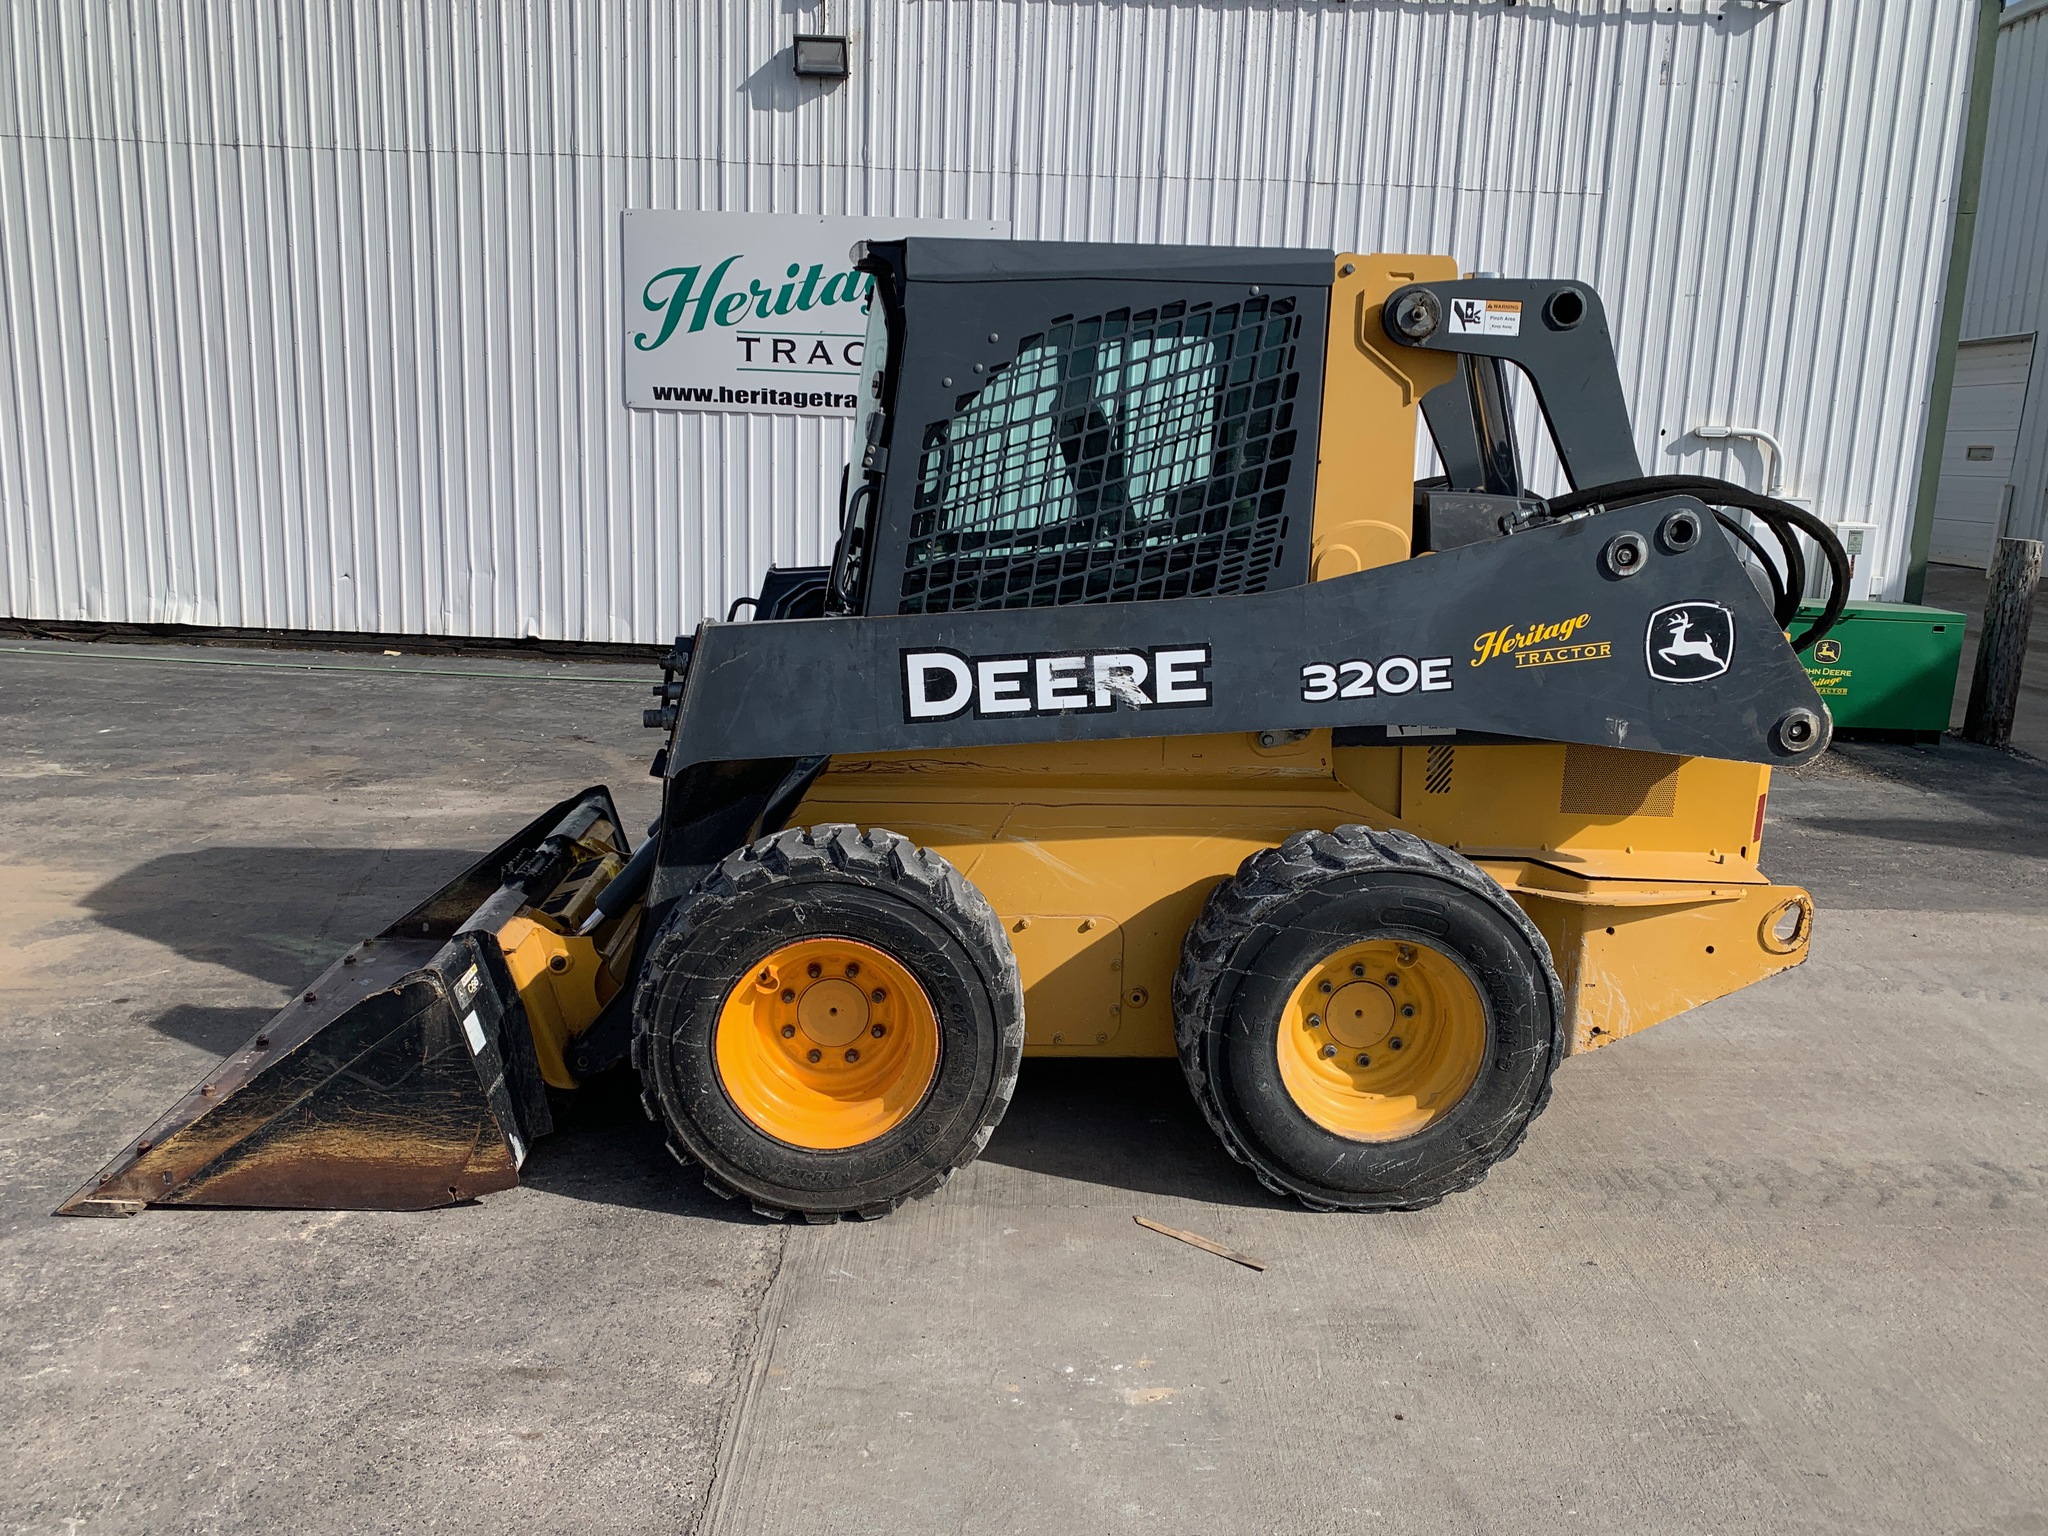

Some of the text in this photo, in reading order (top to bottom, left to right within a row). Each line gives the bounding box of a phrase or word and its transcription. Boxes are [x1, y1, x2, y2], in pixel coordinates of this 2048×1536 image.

[736, 336, 864, 367] TRAC
[653, 386, 858, 409] www.heritagetra
[1471, 613, 1592, 667] Heritage
[1516, 643, 1612, 666] TRACTOR
[906, 649, 1207, 717] DEERE
[1302, 657, 1454, 701] 320E
[1822, 668, 1852, 676] DEERE
